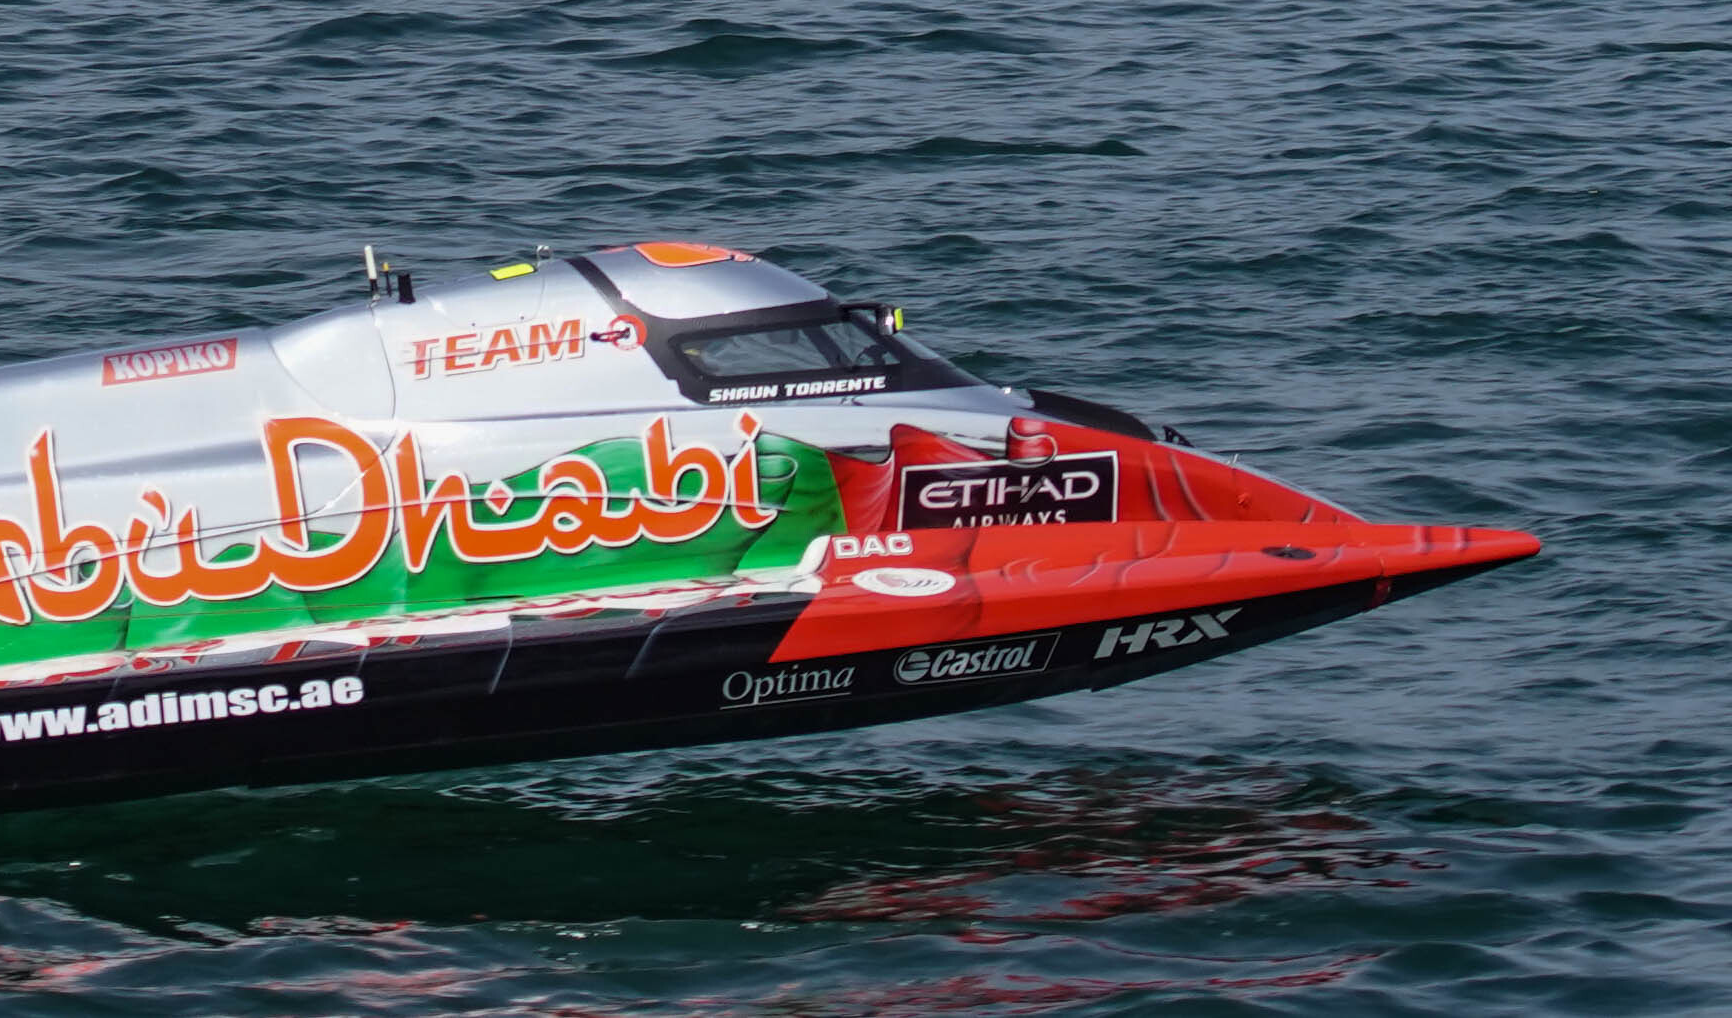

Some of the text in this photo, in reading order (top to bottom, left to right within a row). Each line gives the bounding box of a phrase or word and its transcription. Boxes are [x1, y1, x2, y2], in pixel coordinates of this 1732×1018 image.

[107, 342, 230, 381] KOPIKO
[409, 317, 585, 377] TEAM
[709, 376, 886, 402] SHAUN TORRENTE
[261, 410, 778, 593] Dhabi
[918, 470, 1100, 509] ETIHAD
[952, 509, 1067, 529] AIRWAYS
[832, 533, 913, 559] DAC
[1093, 607, 1243, 659] HRX
[930, 640, 1038, 678] Castrol
[721, 664, 856, 705] Optima
